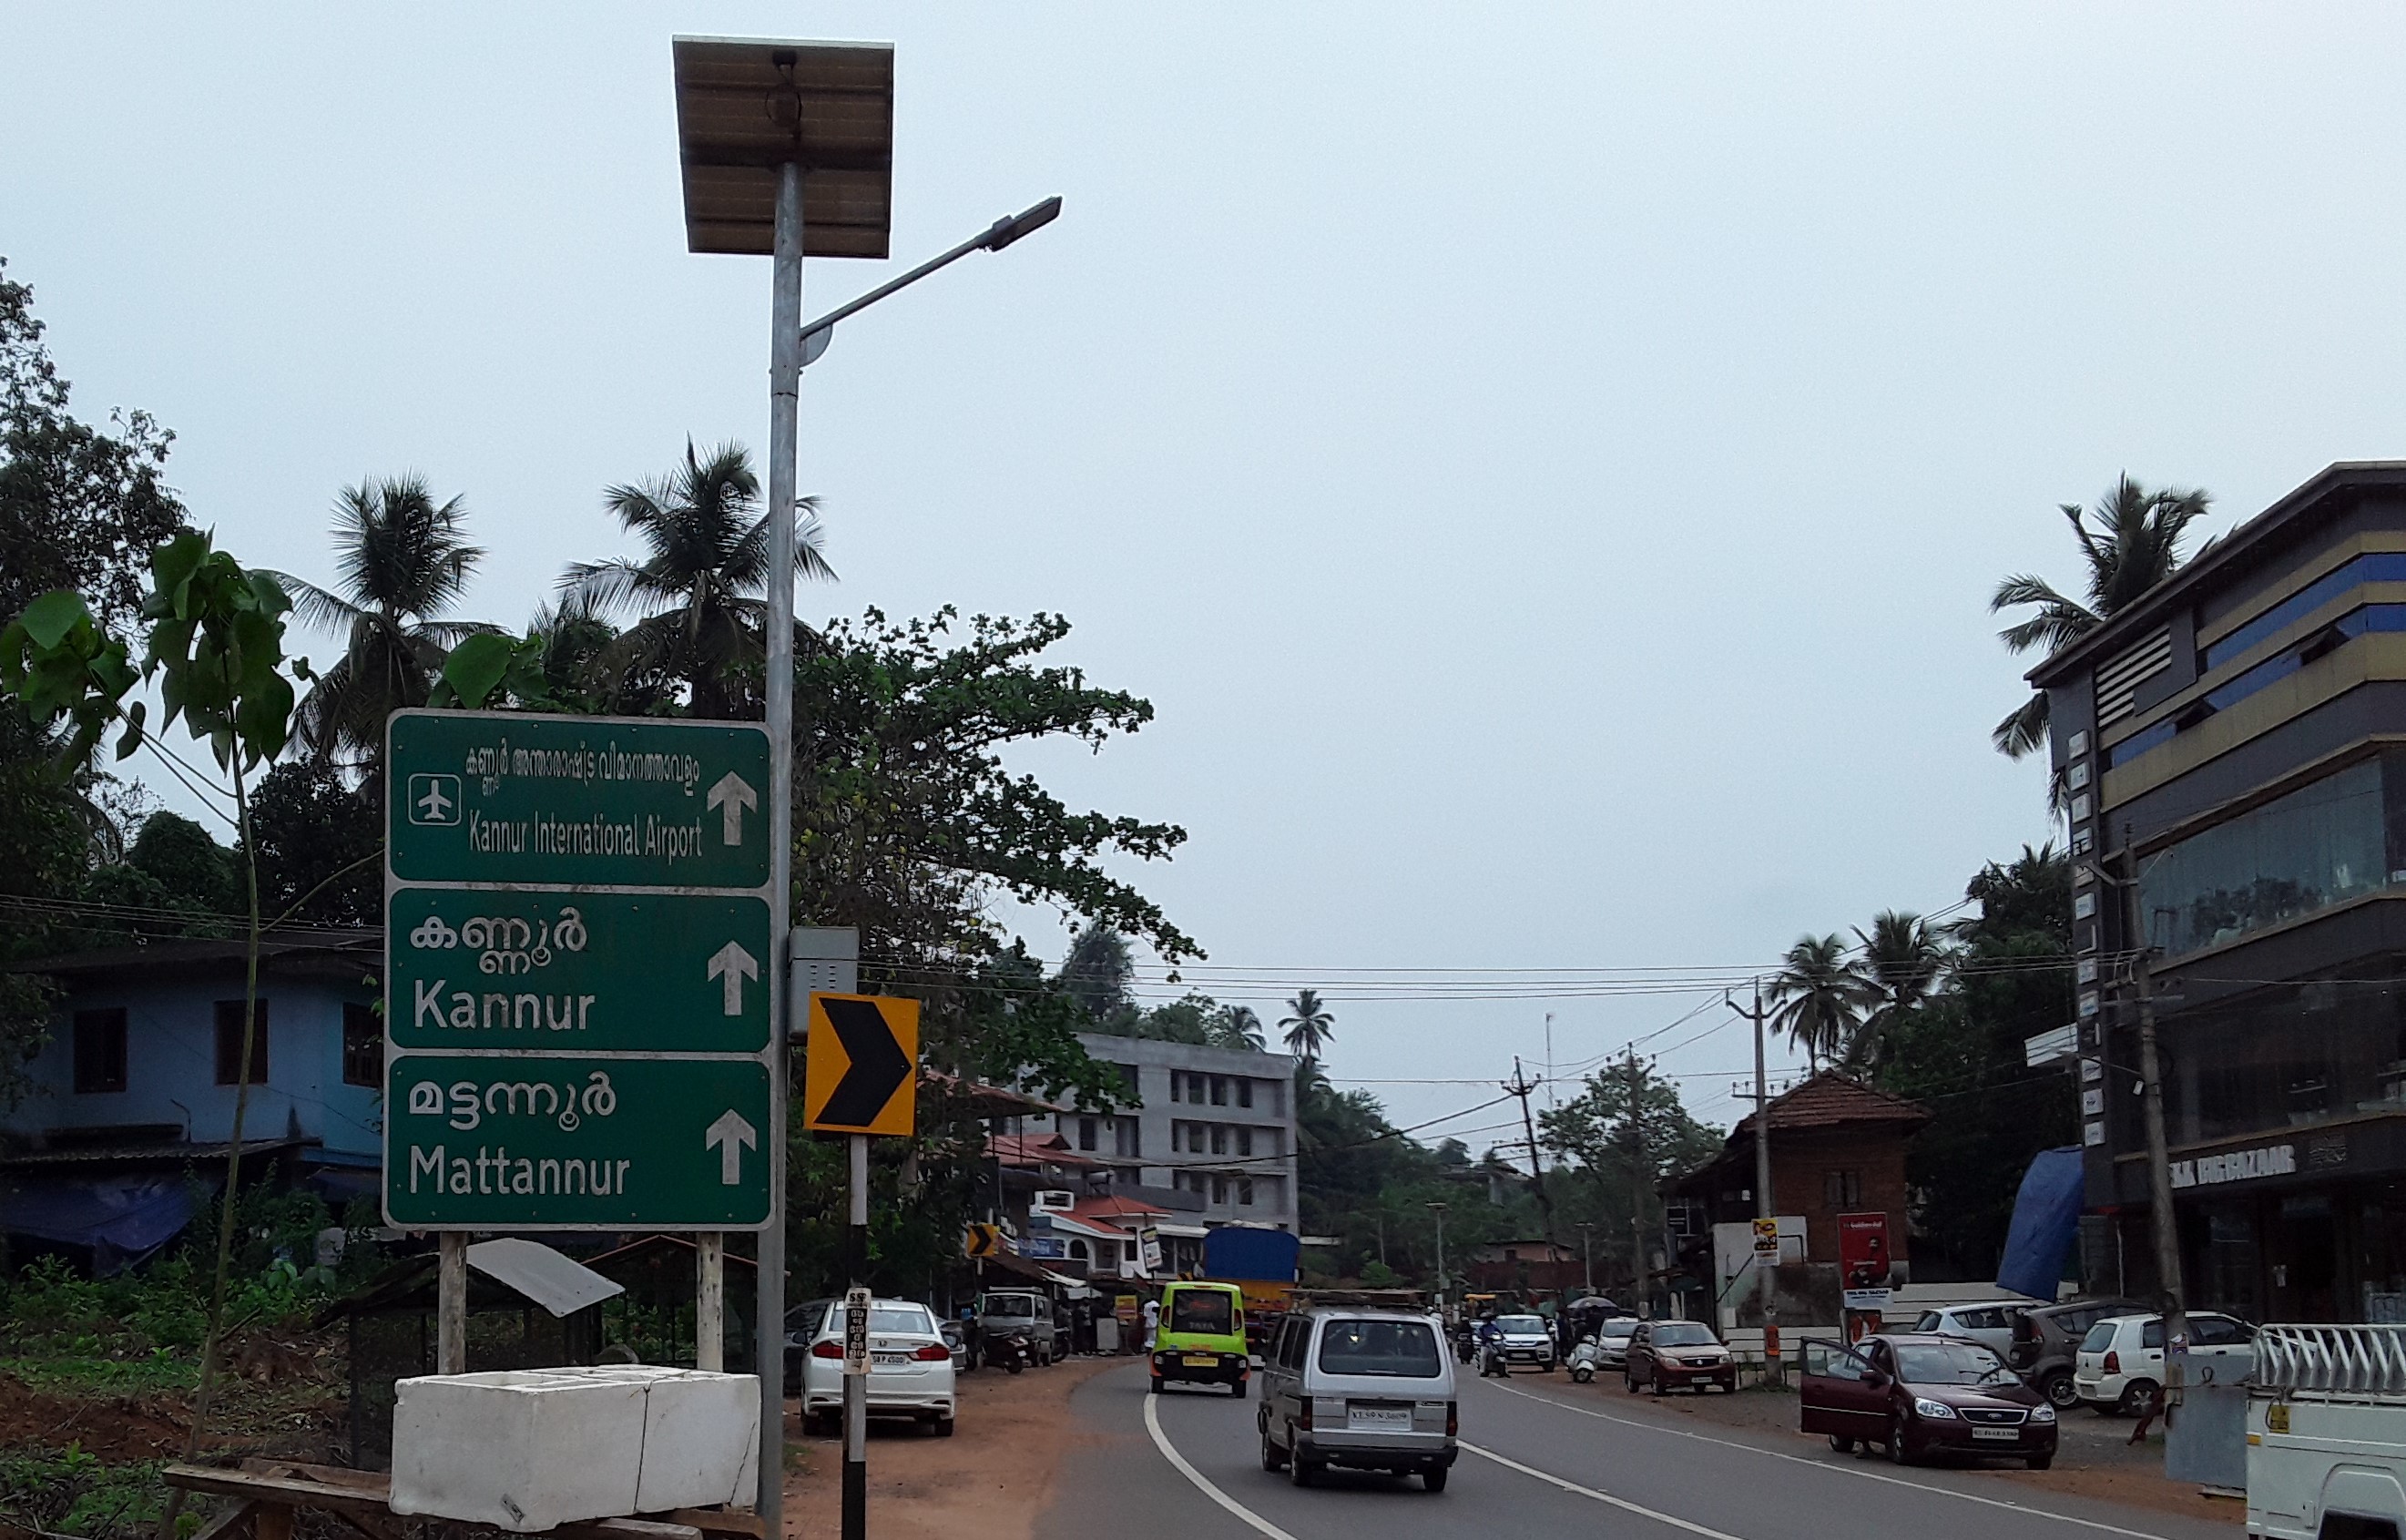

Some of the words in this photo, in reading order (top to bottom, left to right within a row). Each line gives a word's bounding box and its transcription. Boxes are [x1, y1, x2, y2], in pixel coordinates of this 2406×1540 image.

[469, 809, 528, 853] Kannur
[535, 811, 640, 856] International
[645, 814, 702, 866] Airport
[414, 979, 596, 1031] Kannur
[409, 1070, 617, 1132] മട്ടന്നൂർ
[410, 1145, 630, 1196] Mattannur
